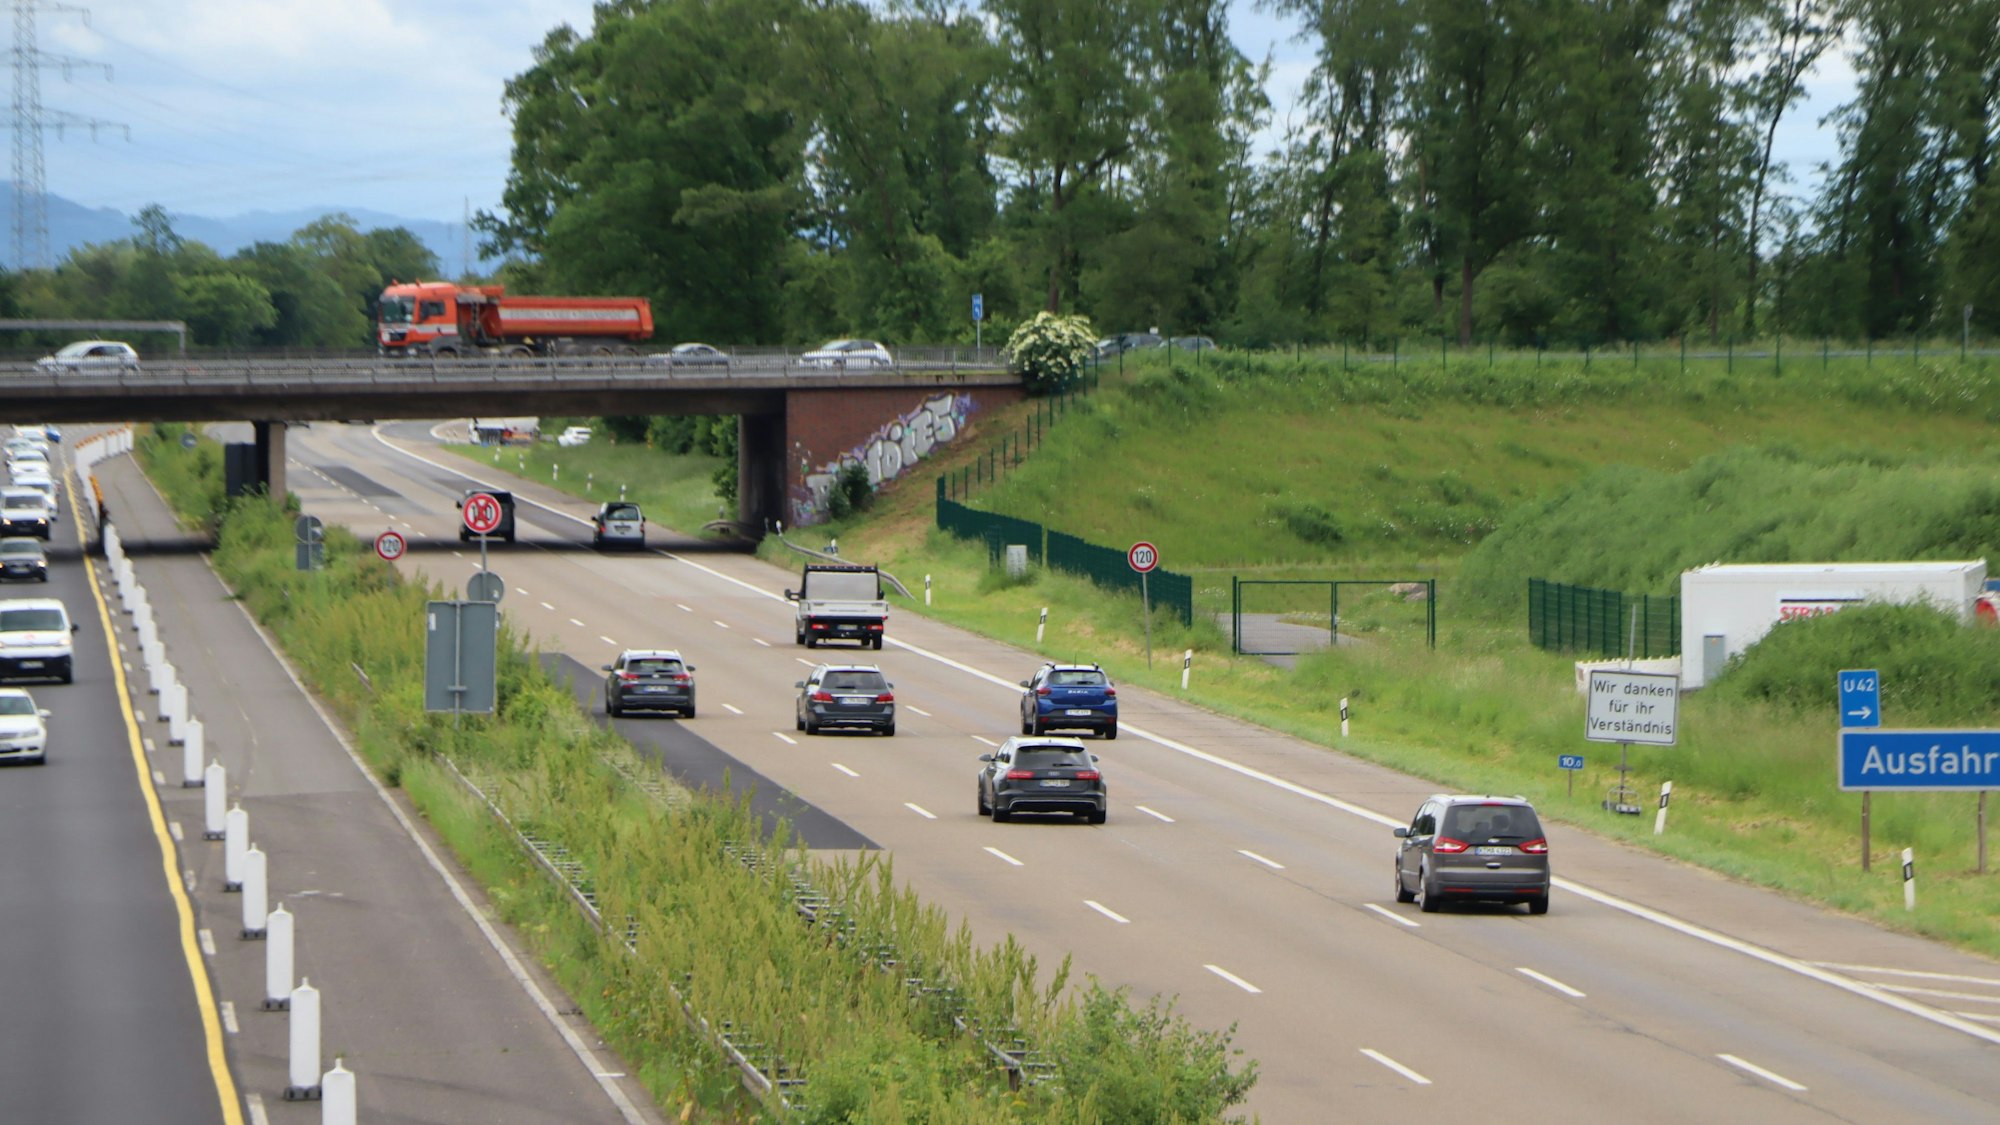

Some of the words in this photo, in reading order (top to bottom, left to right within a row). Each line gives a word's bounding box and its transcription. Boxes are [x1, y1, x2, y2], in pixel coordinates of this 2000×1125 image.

[472, 503, 494, 521] 10
[382, 538, 400, 553] 120
[1135, 551, 1151, 563] 120
[1593, 680, 1616, 693] Wir
[1624, 683, 1673, 697] danken
[1608, 699, 1629, 713] für
[1636, 702, 1654, 714] ihr
[1590, 717, 1672, 735] Verständnis
